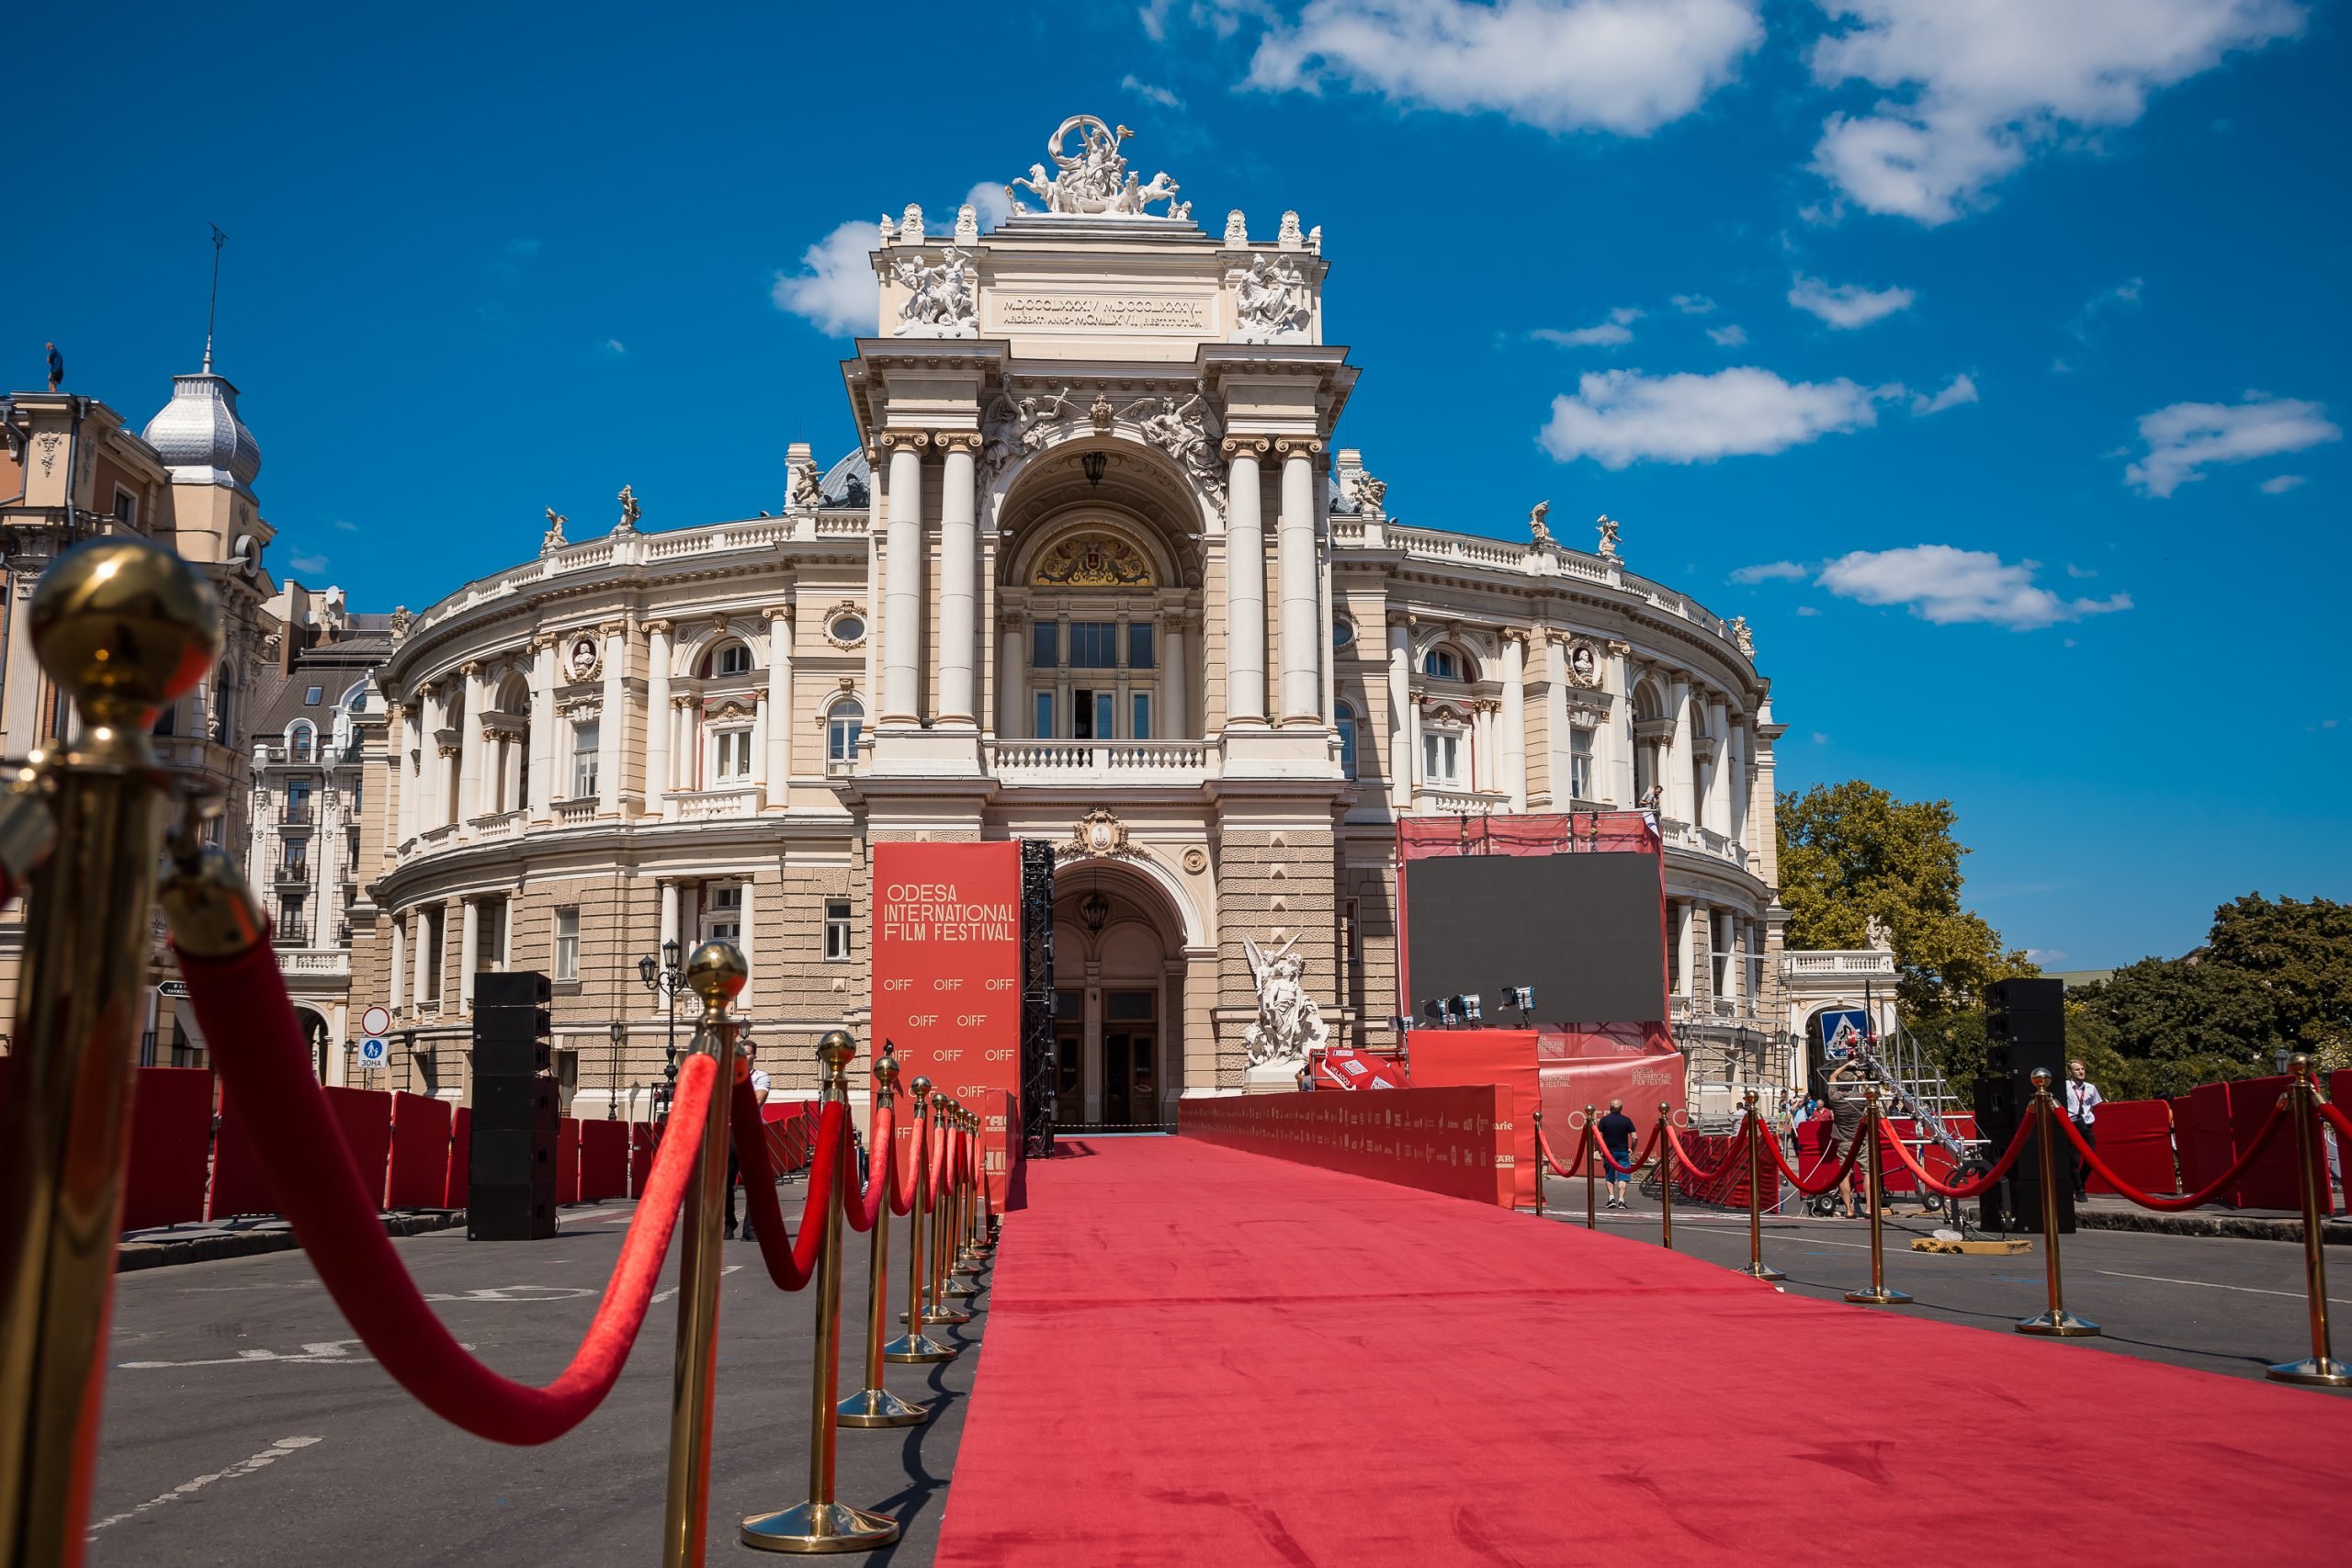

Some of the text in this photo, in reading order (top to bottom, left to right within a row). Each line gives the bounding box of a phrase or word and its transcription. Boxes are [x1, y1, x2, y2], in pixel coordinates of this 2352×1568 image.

[887, 884, 957, 902] ODESA
[884, 904, 1015, 922] INTERNATIONAL
[884, 923, 1014, 942] FILM FESTIVAL
[883, 979, 1015, 991] OIFF OIFF OIFF
[908, 1015, 988, 1027] OIFF OIFF
[933, 1049, 964, 1062] OIFF
[985, 1049, 1015, 1062] OIFF
[1329, 1065, 1351, 1086] HELADOS
[956, 1086, 988, 1098] OIFF
[1494, 1121, 1513, 1130] arie
